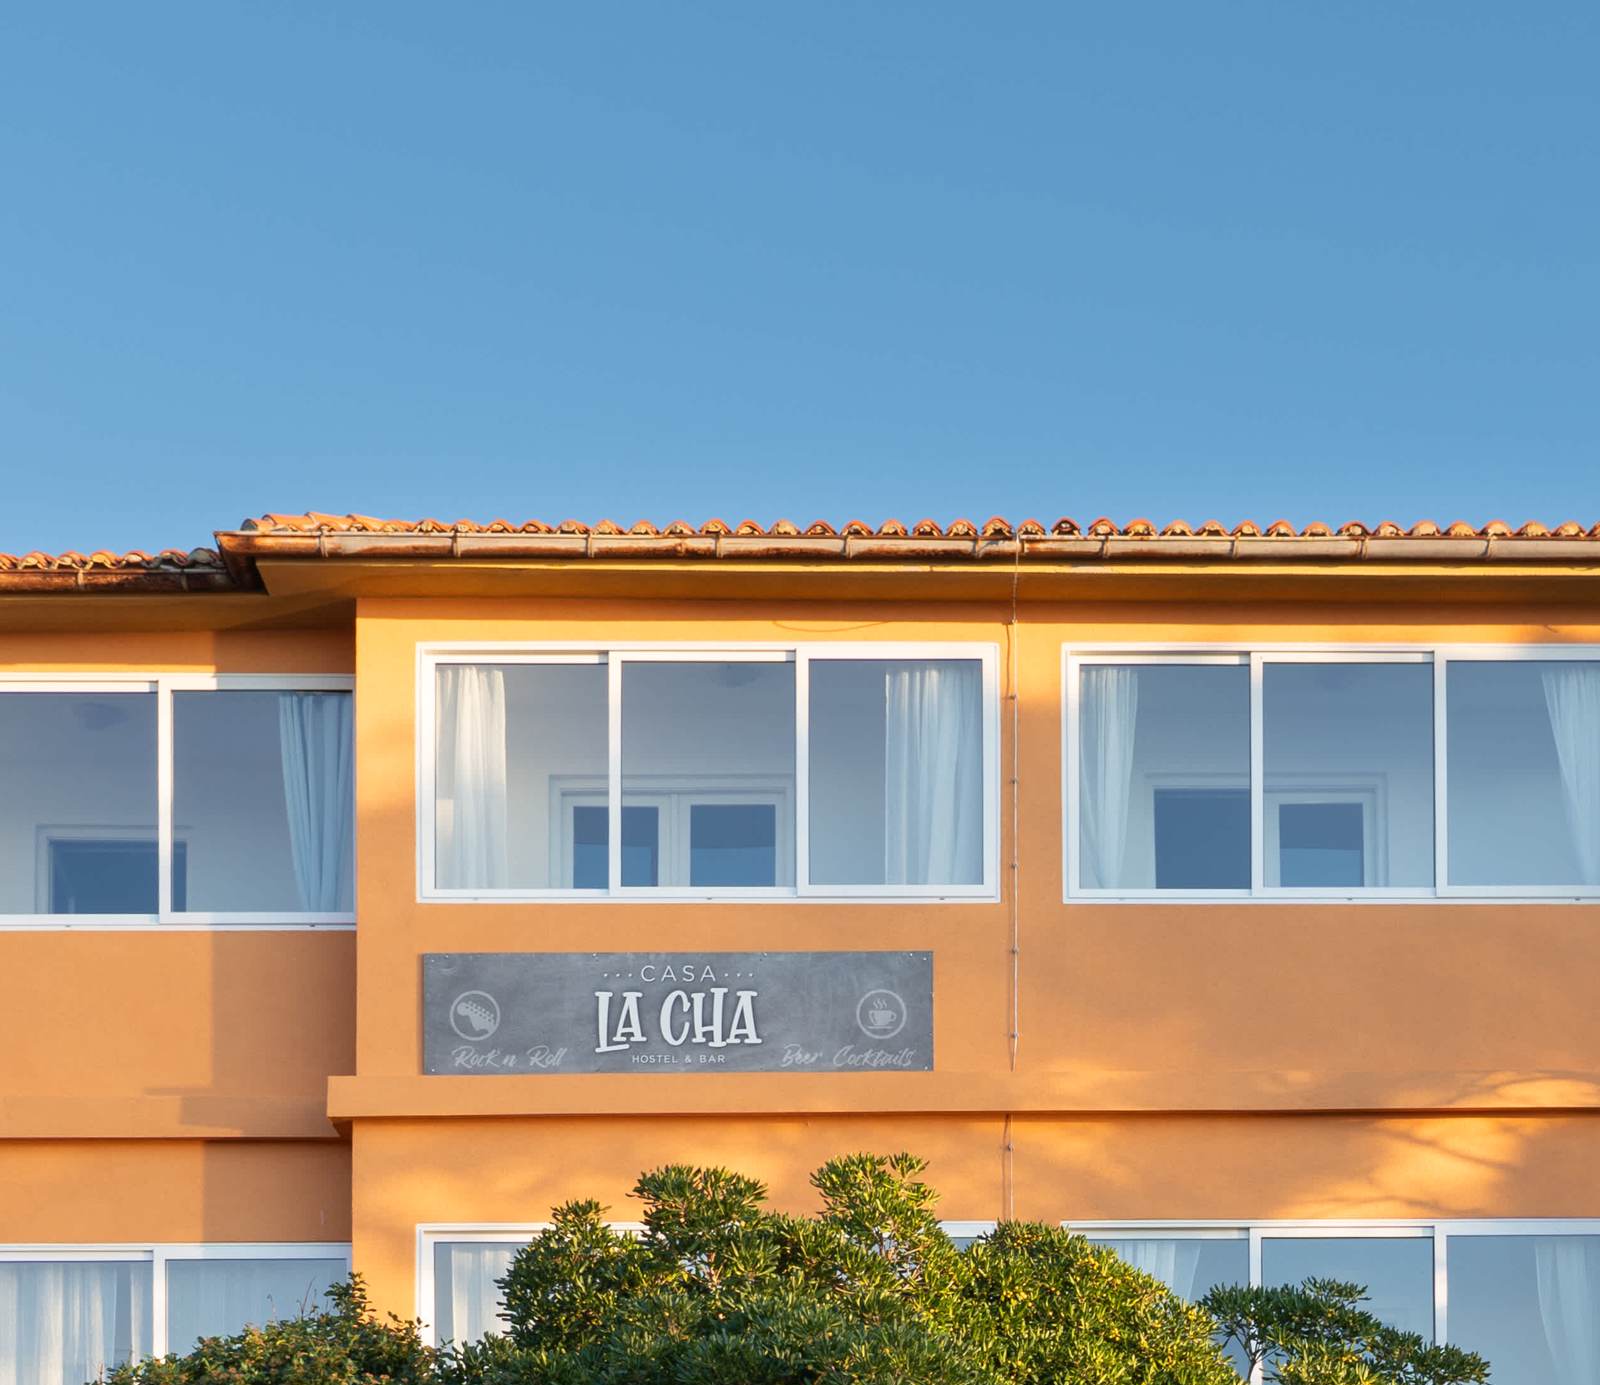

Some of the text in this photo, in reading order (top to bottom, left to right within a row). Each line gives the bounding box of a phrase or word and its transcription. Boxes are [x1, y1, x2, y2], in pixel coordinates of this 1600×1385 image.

[641, 965, 716, 982] CASA
[594, 987, 763, 1053] LA CHA
[526, 1045, 568, 1068] Roll
[632, 1055, 726, 1063] HOSTEL & BAR
[779, 1043, 916, 1067] Beer Cocktails
